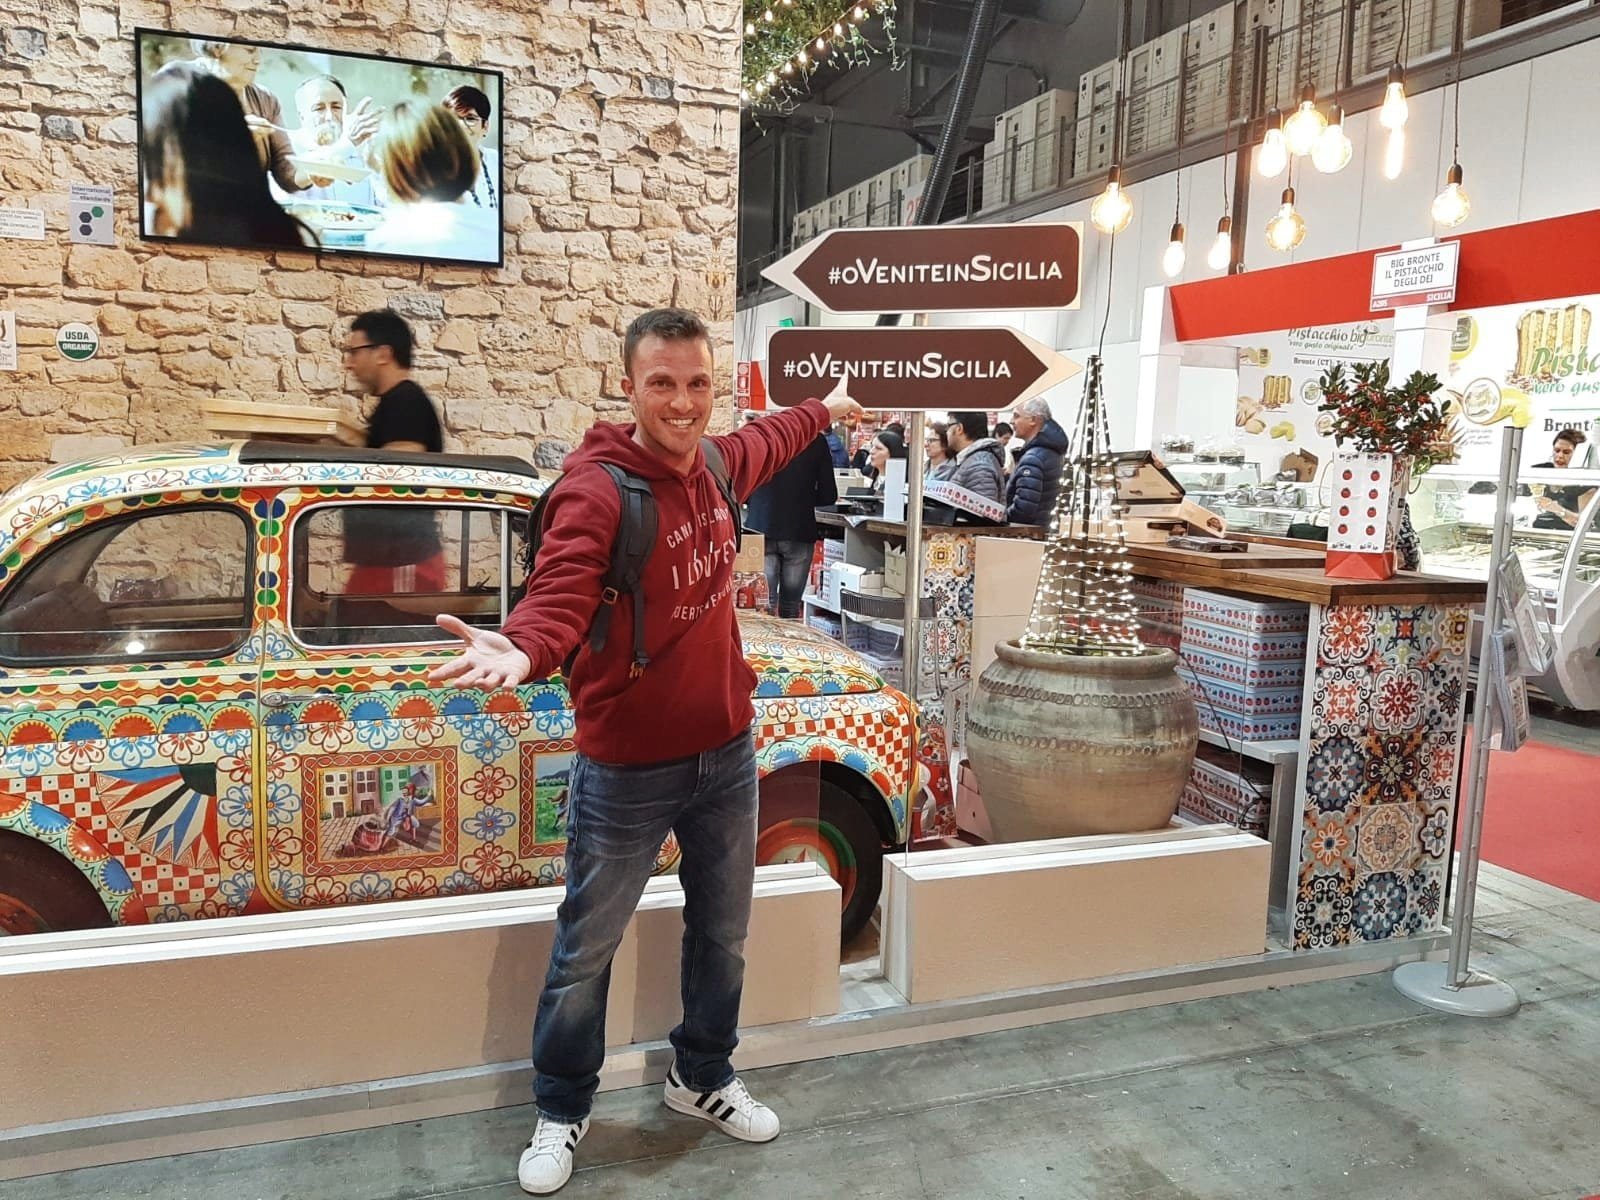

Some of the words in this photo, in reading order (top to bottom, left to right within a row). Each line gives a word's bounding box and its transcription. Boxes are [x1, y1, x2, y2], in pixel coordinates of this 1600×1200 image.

[1391, 258, 1405, 269] BIG
[1407, 252, 1440, 266] BRONTE
[1385, 270, 1392, 279] IL
[1394, 262, 1444, 278] PISTACCHIO
[1393, 275, 1417, 288] DEGLI
[1419, 274, 1433, 284] DEI
[1427, 291, 1452, 302] SICILIA
[65, 331, 89, 340] USDA
[62, 342, 93, 351] ORGANIC
